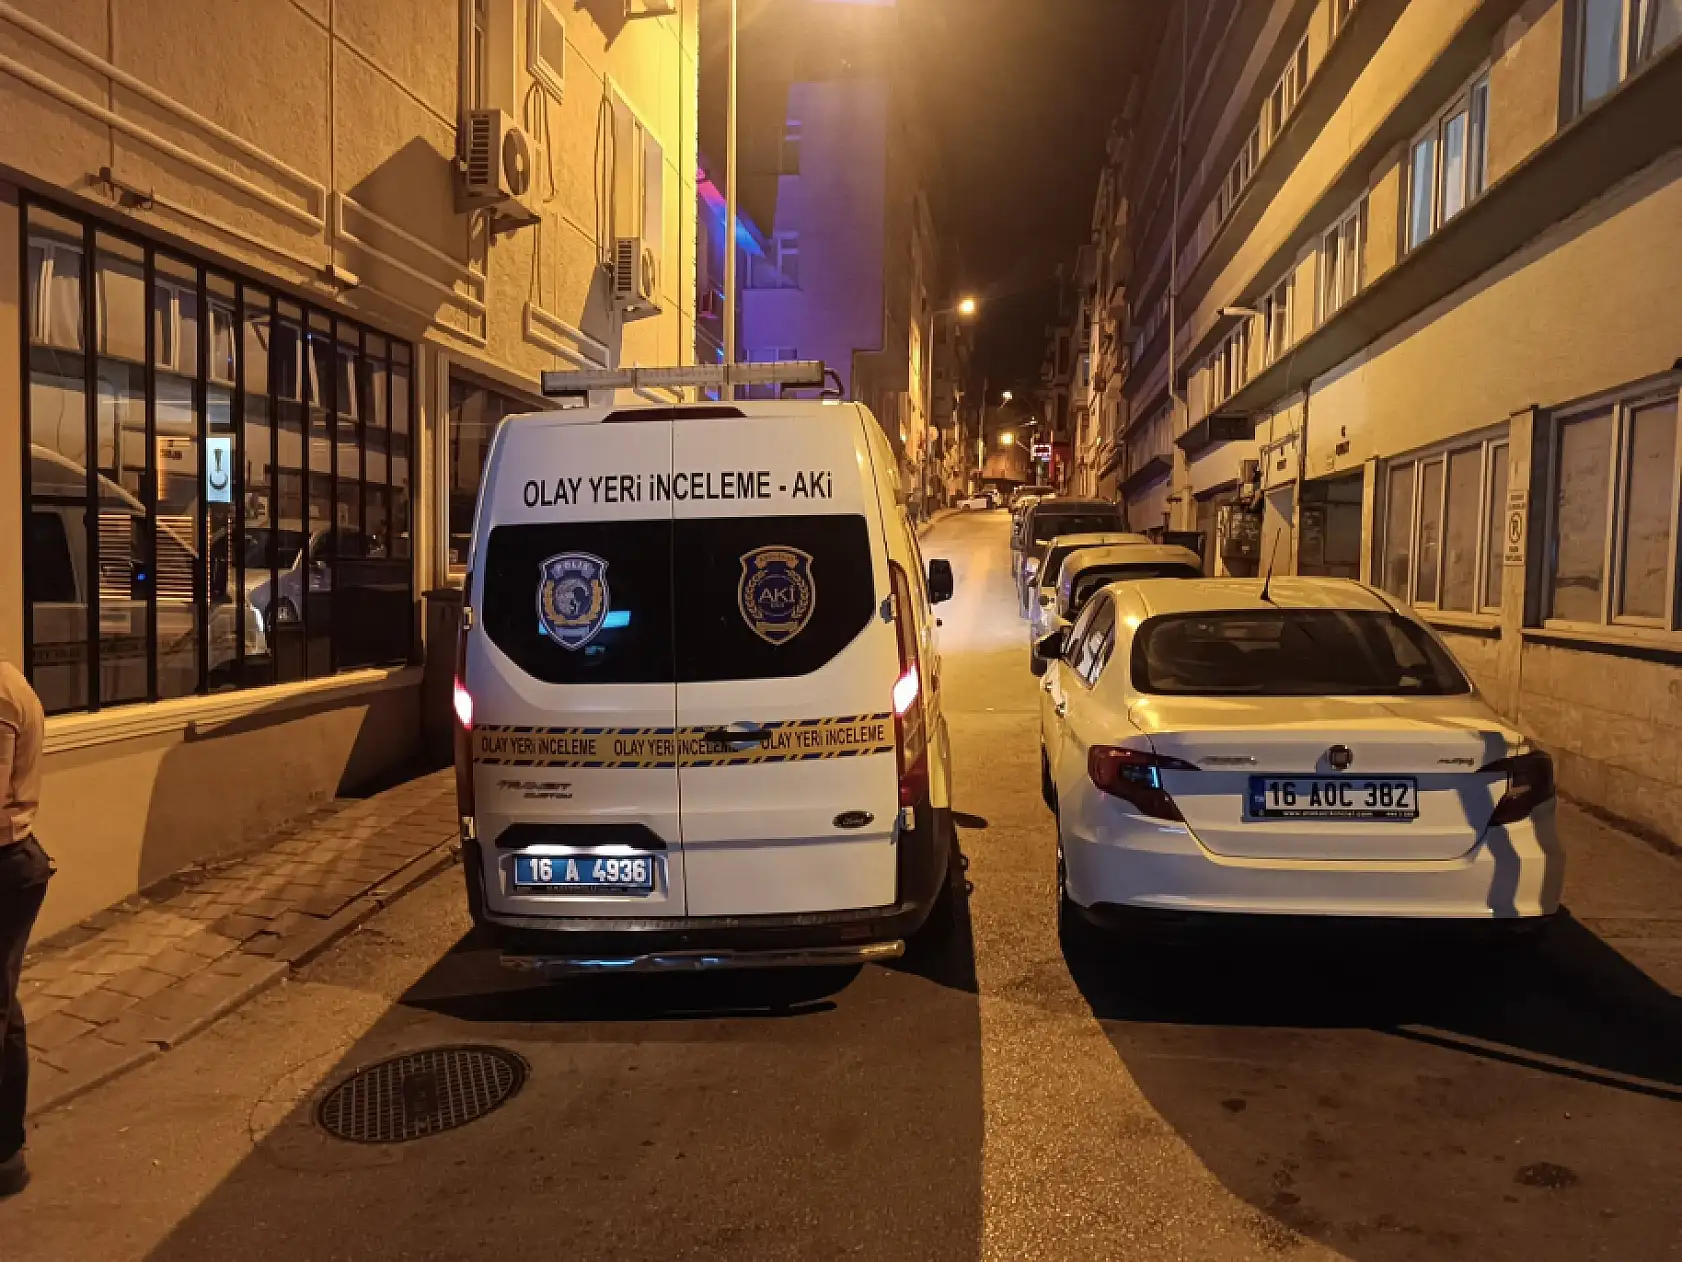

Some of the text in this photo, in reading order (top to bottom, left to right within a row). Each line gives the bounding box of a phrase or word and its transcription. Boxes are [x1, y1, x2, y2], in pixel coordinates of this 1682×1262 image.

[523, 477, 582, 508] OLAY
[481, 736, 508, 753] OLAY
[614, 739, 645, 756] OLAY
[1269, 781, 1297, 808] 16
[1365, 782, 1410, 808] 382
[530, 858, 647, 882] 16 A 4936
